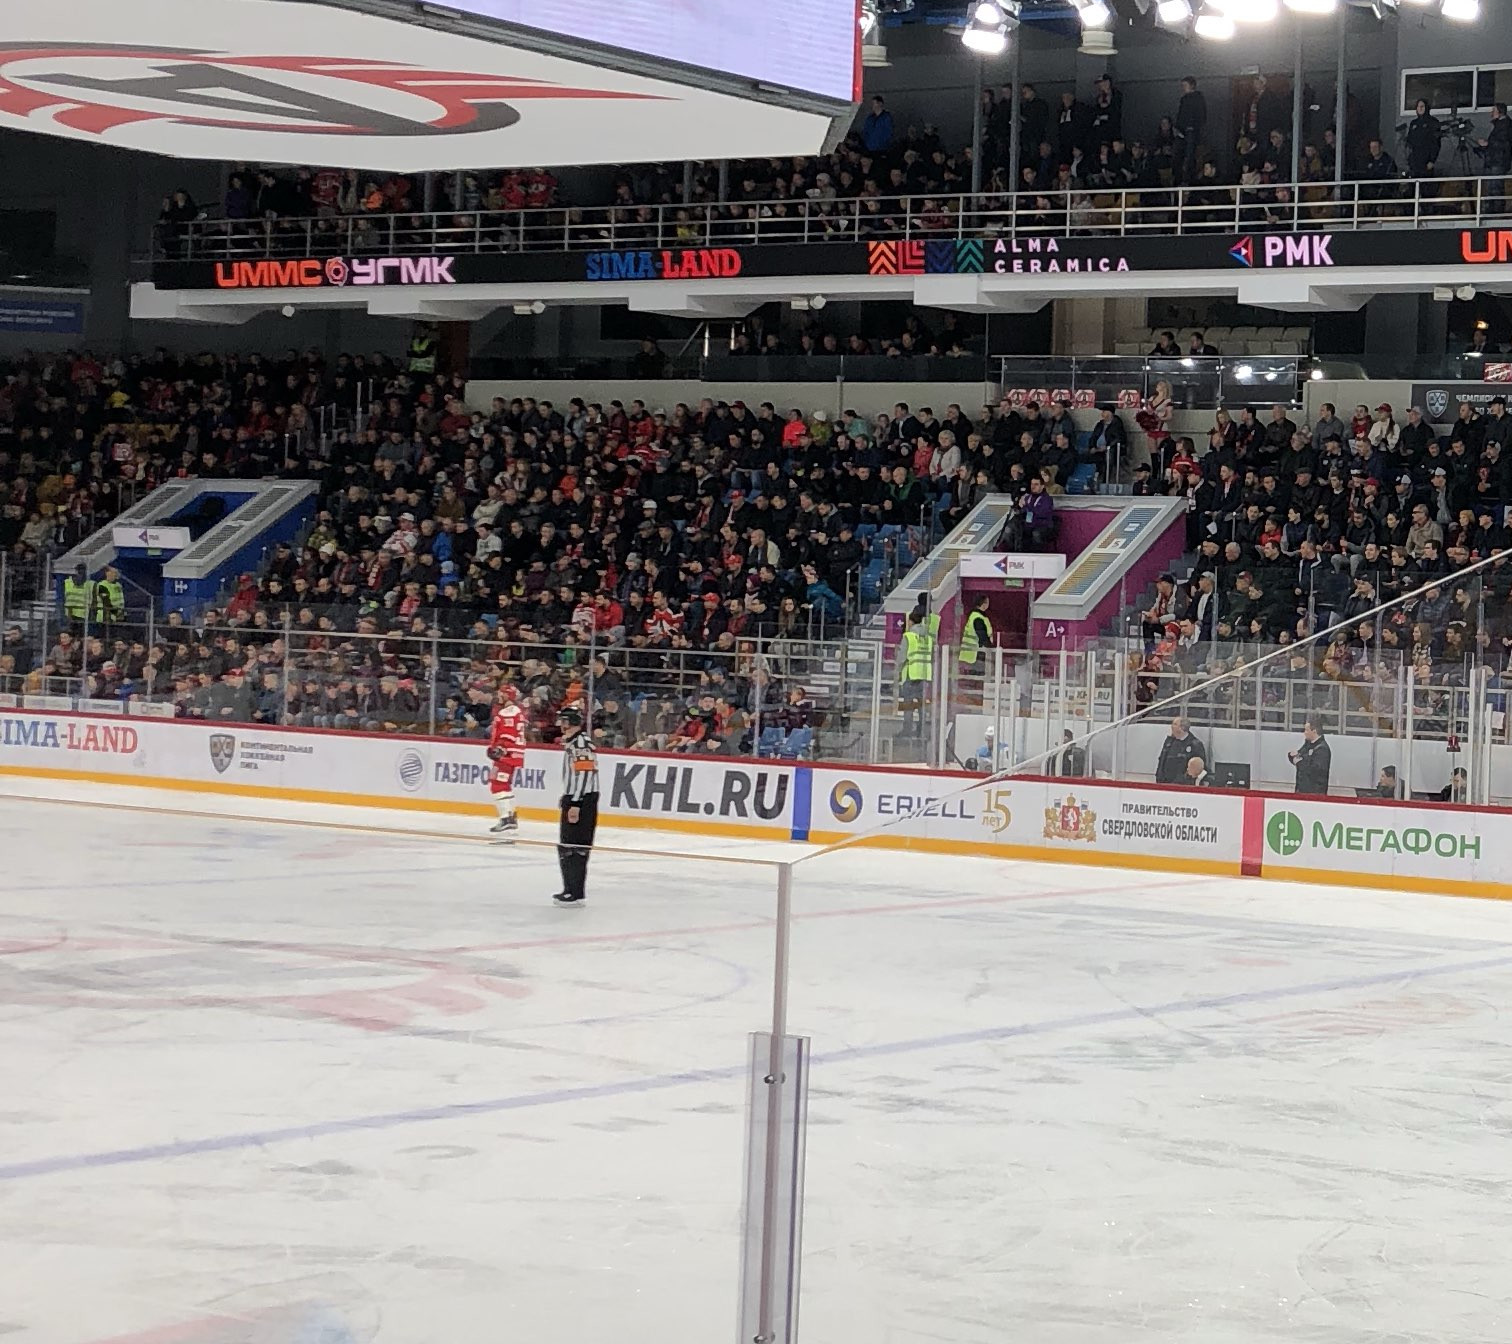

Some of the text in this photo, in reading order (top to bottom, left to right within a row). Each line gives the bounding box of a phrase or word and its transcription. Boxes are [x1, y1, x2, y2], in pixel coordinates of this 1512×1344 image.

[994, 238, 1059, 254] ALMA
[216, 260, 323, 287] UMMC
[352, 256, 456, 285] УГМК
[586, 248, 741, 280] SIMA-LAND
[995, 258, 1130, 273] CERAMICA
[0, 718, 138, 754] IMA-LAND
[434, 761, 547, 790] ГАЗПРОАНК
[610, 762, 789, 820] KHL.RU
[1122, 801, 1198, 819] ПРАВИТЕЛЬСТВО
[1102, 818, 1218, 844] СВЕРДЛОВСКОЙ ОБЛАСТИ
